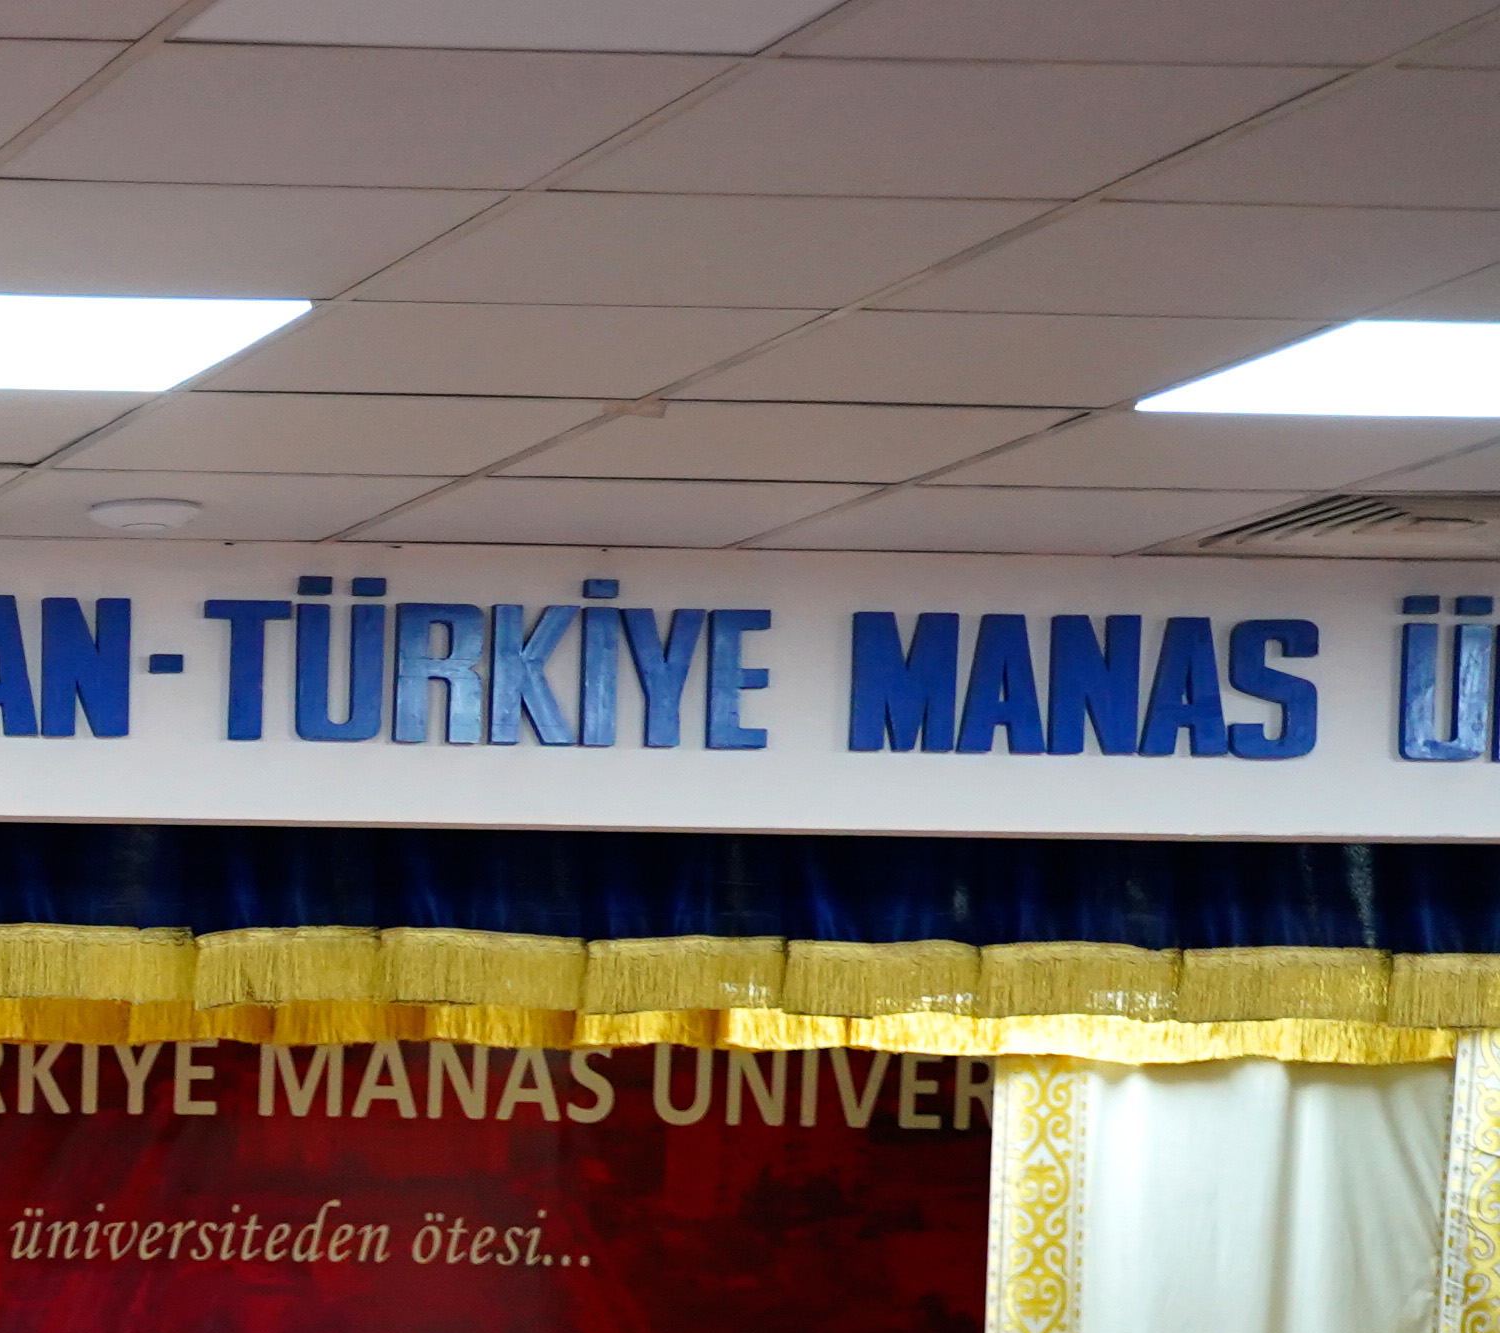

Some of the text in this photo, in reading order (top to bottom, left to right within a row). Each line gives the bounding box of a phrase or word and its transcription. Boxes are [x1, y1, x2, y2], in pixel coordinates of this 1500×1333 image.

[847, 610, 1319, 762] MANAS
[11, 1199, 389, 1263] üniversiteden
[411, 1209, 591, 1266] ötesi...
